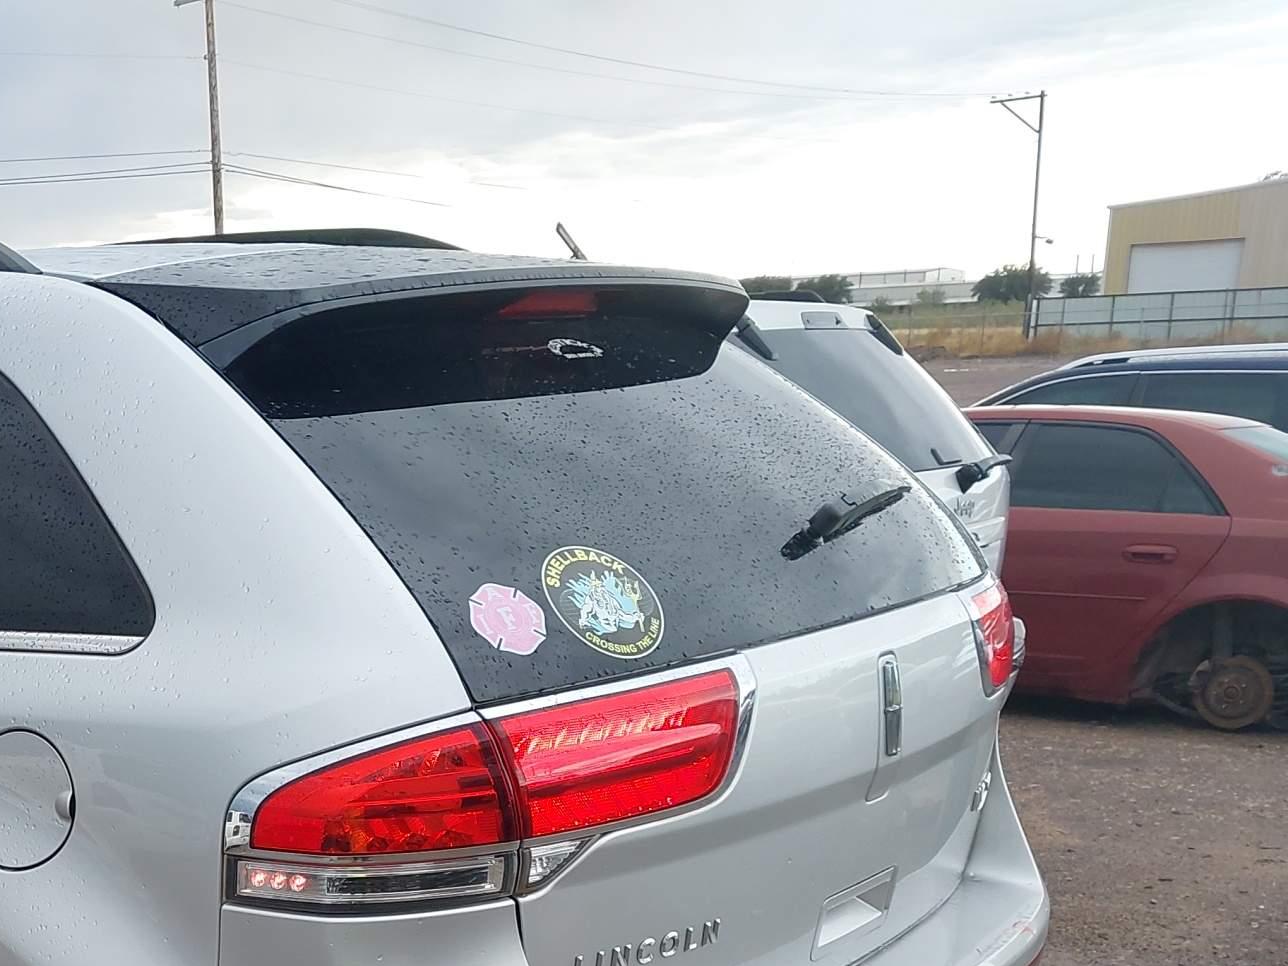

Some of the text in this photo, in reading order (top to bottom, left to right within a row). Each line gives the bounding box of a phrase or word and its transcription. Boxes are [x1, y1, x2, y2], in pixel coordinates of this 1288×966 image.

[546, 549, 626, 588] SHELLBACK
[585, 617, 661, 654] CROSSING THE LINE
